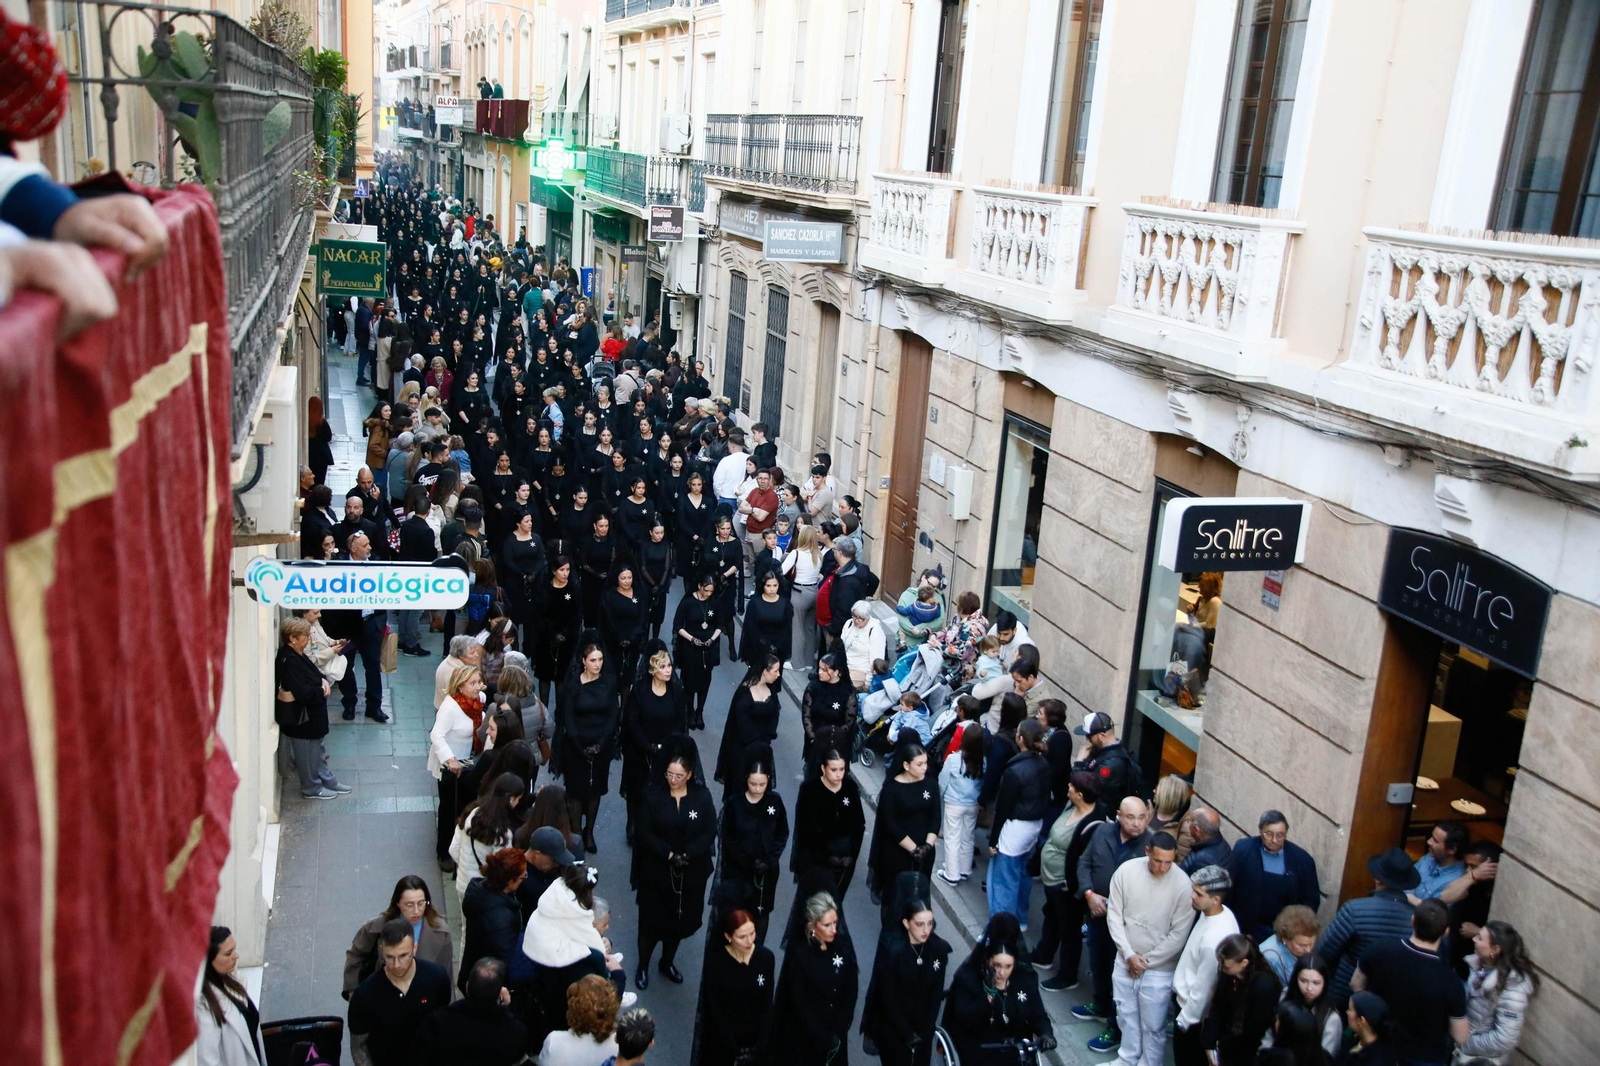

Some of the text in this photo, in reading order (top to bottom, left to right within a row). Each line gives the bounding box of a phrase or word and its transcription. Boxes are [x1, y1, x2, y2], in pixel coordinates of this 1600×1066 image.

[438, 97, 458, 106] ALFA
[722, 205, 758, 226] SANCHEZ
[770, 228, 796, 241] SANCHEZ
[798, 229, 824, 242] CAZORLA
[323, 247, 382, 266] NACAR
[1195, 518, 1282, 550] Salitre
[284, 572, 464, 602] Audiológica
[1405, 546, 1514, 630] Salitre
[282, 595, 400, 604] Centros auditivos
